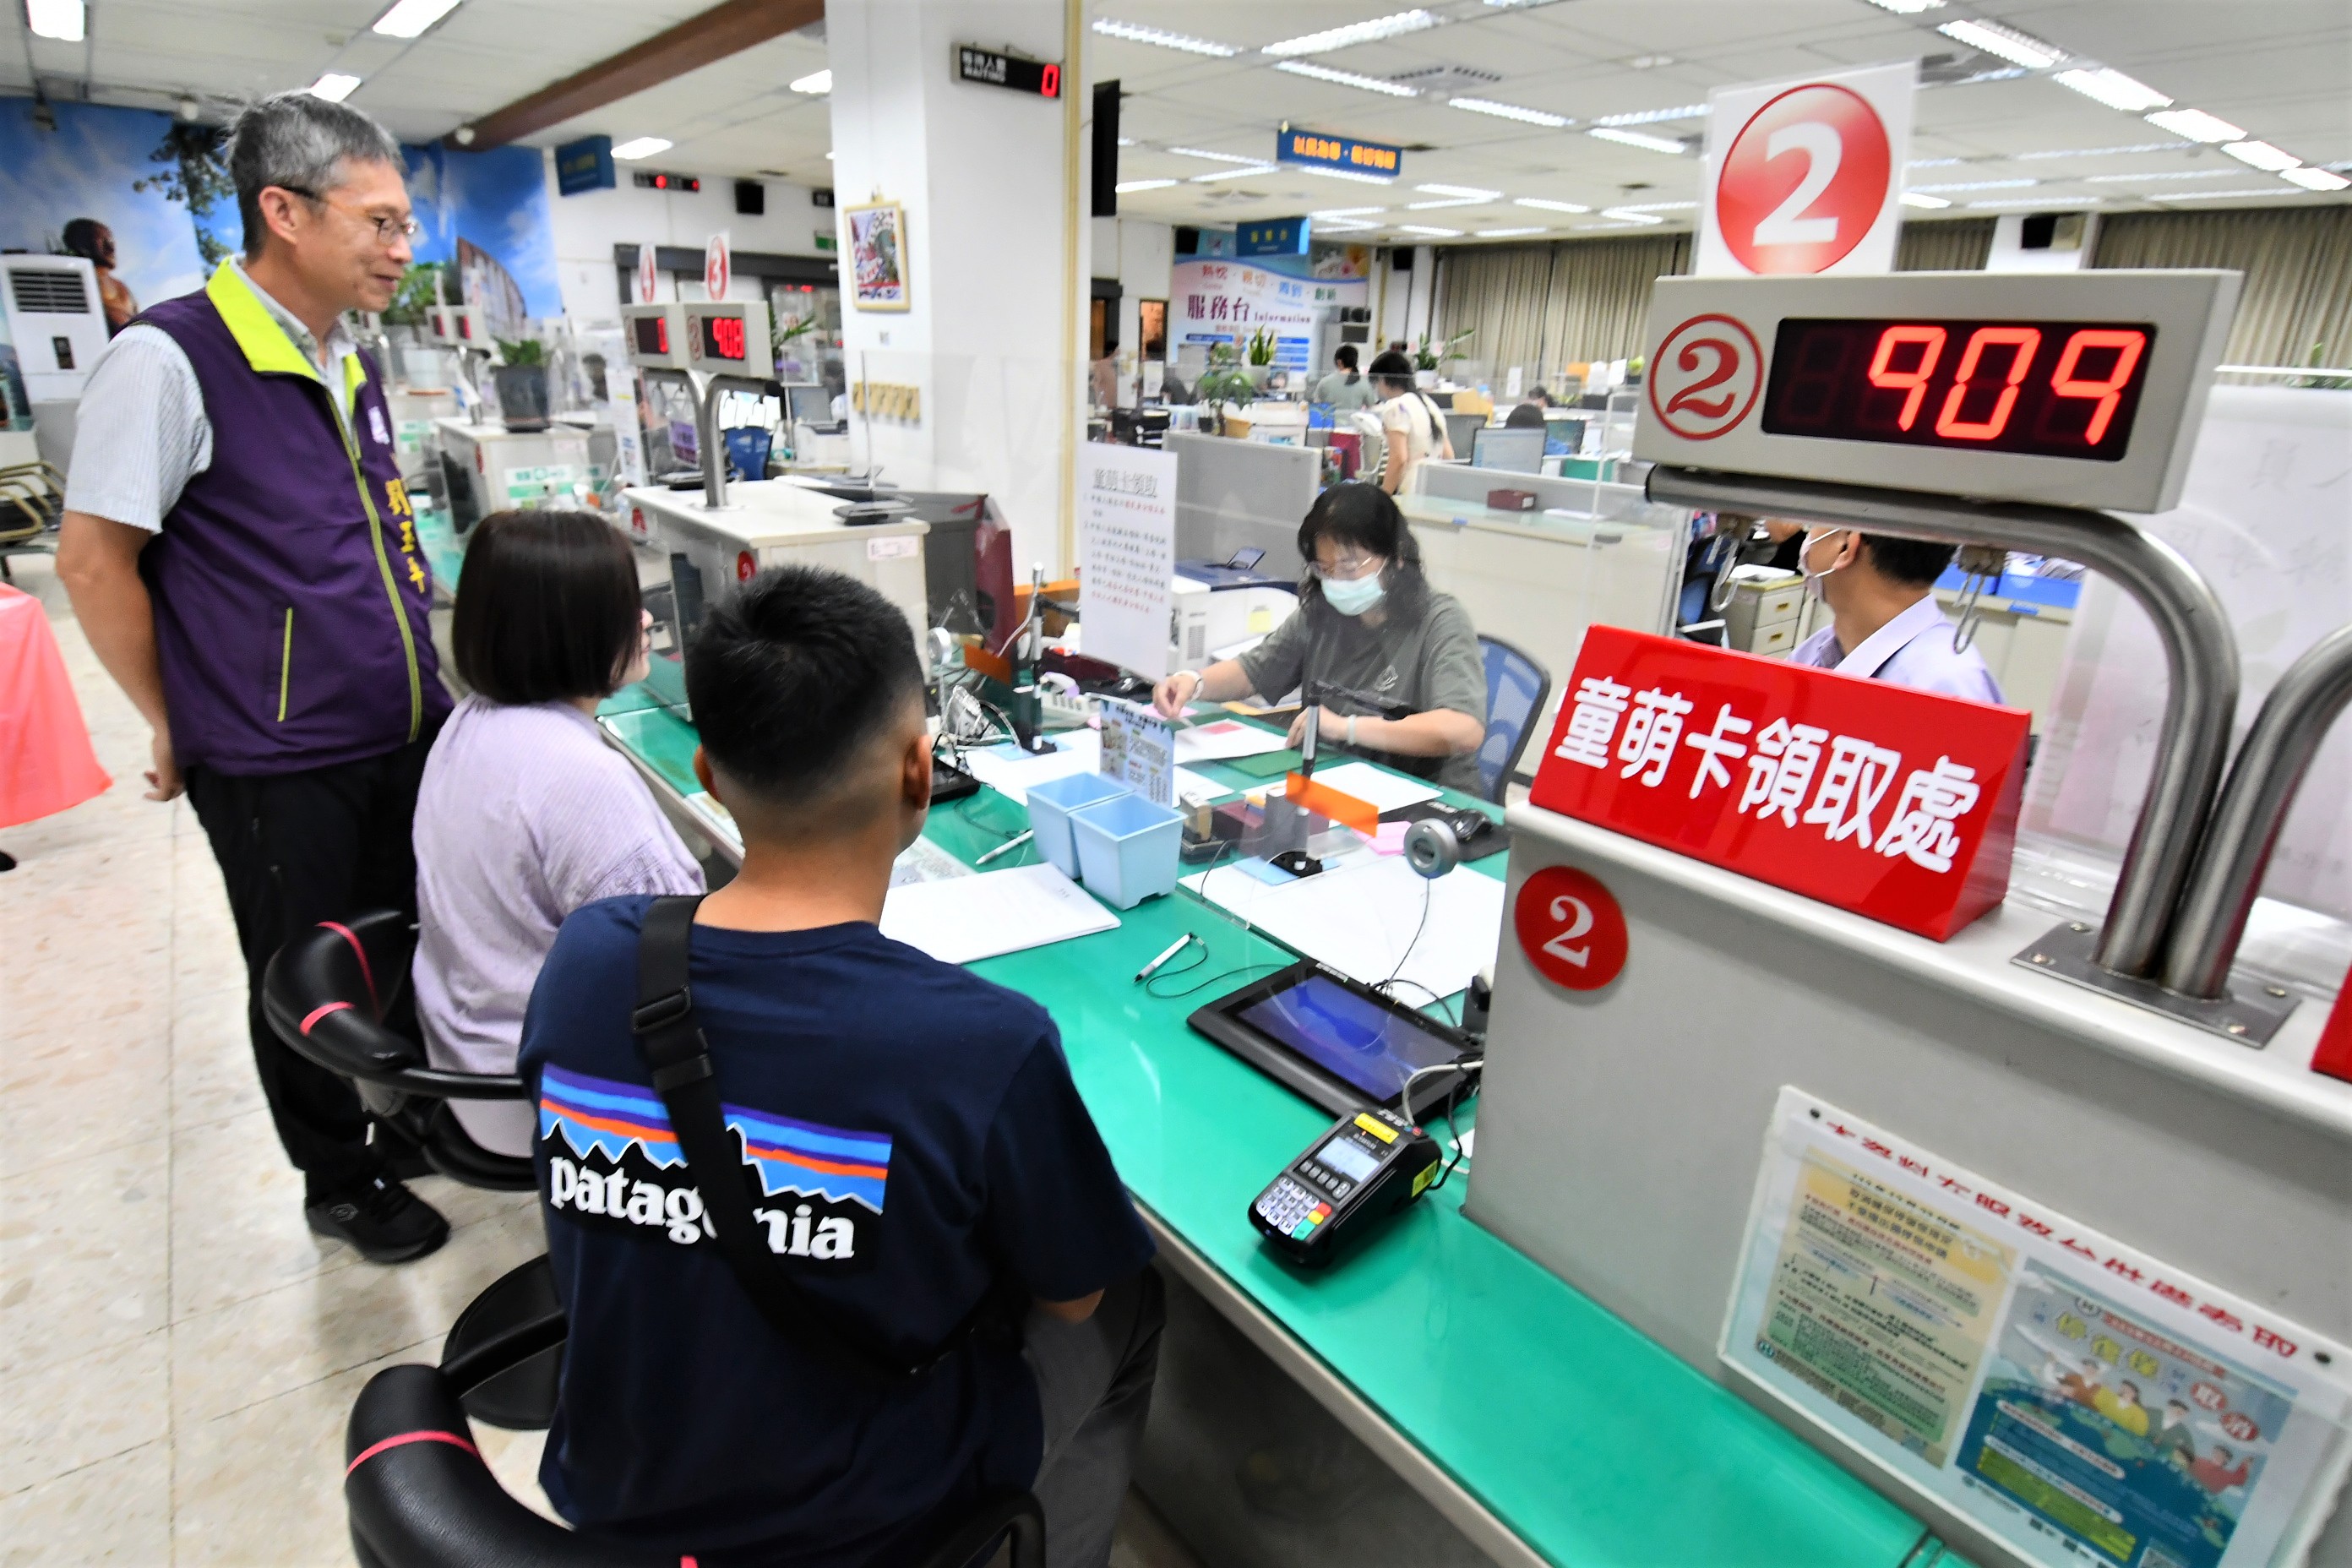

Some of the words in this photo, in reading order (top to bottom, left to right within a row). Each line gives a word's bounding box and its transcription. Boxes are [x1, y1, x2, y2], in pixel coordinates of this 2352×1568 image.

[1041, 63, 1059, 97] 0
[1753, 122, 1842, 247] 2
[1187, 294, 1250, 322] 服務台
[1255, 311, 1311, 324] Information
[1667, 338, 1740, 419] 2
[1868, 326, 2147, 446] 909
[1554, 676, 1979, 874] 童萌卡領取處
[1542, 895, 1594, 968] 2
[550, 1156, 855, 1260] patagnia
